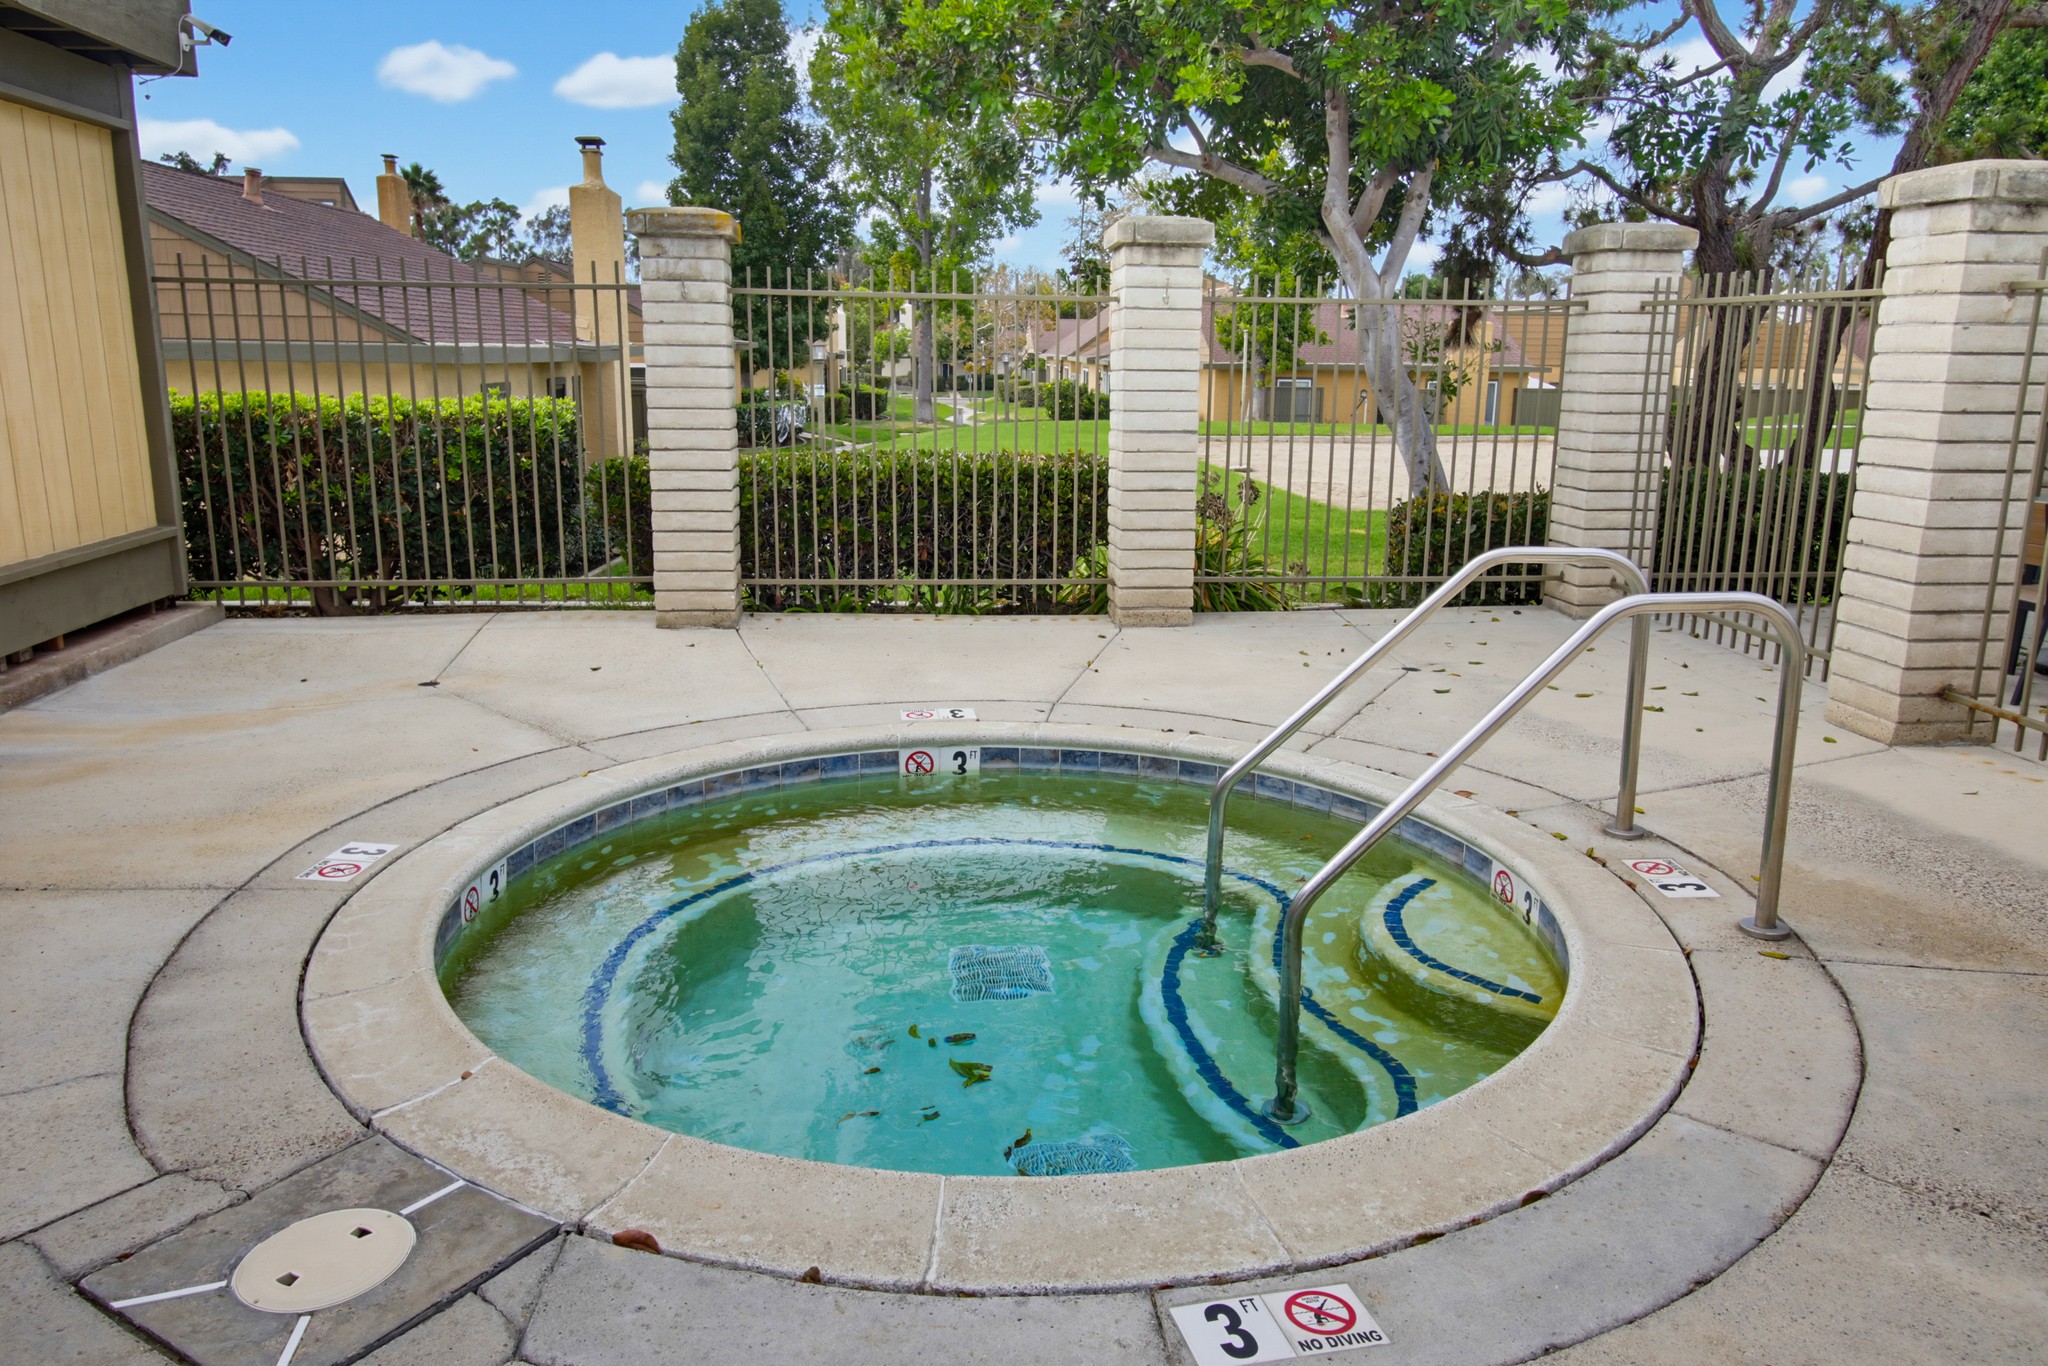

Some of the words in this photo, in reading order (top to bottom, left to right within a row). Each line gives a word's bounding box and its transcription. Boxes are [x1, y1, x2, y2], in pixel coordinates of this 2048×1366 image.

[949, 709, 965, 719] 3
[951, 751, 967, 775] 3
[970, 750, 977, 759] FT
[340, 847, 387, 855] 3
[490, 870, 499, 903] 3
[1658, 882, 1707, 892] 3
[1523, 891, 1533, 926] 3
[1204, 1303, 1259, 1359] 3
[1238, 1298, 1259, 1313] FT
[1297, 1338, 1324, 1352] NO
[1324, 1330, 1383, 1348] DIVING
